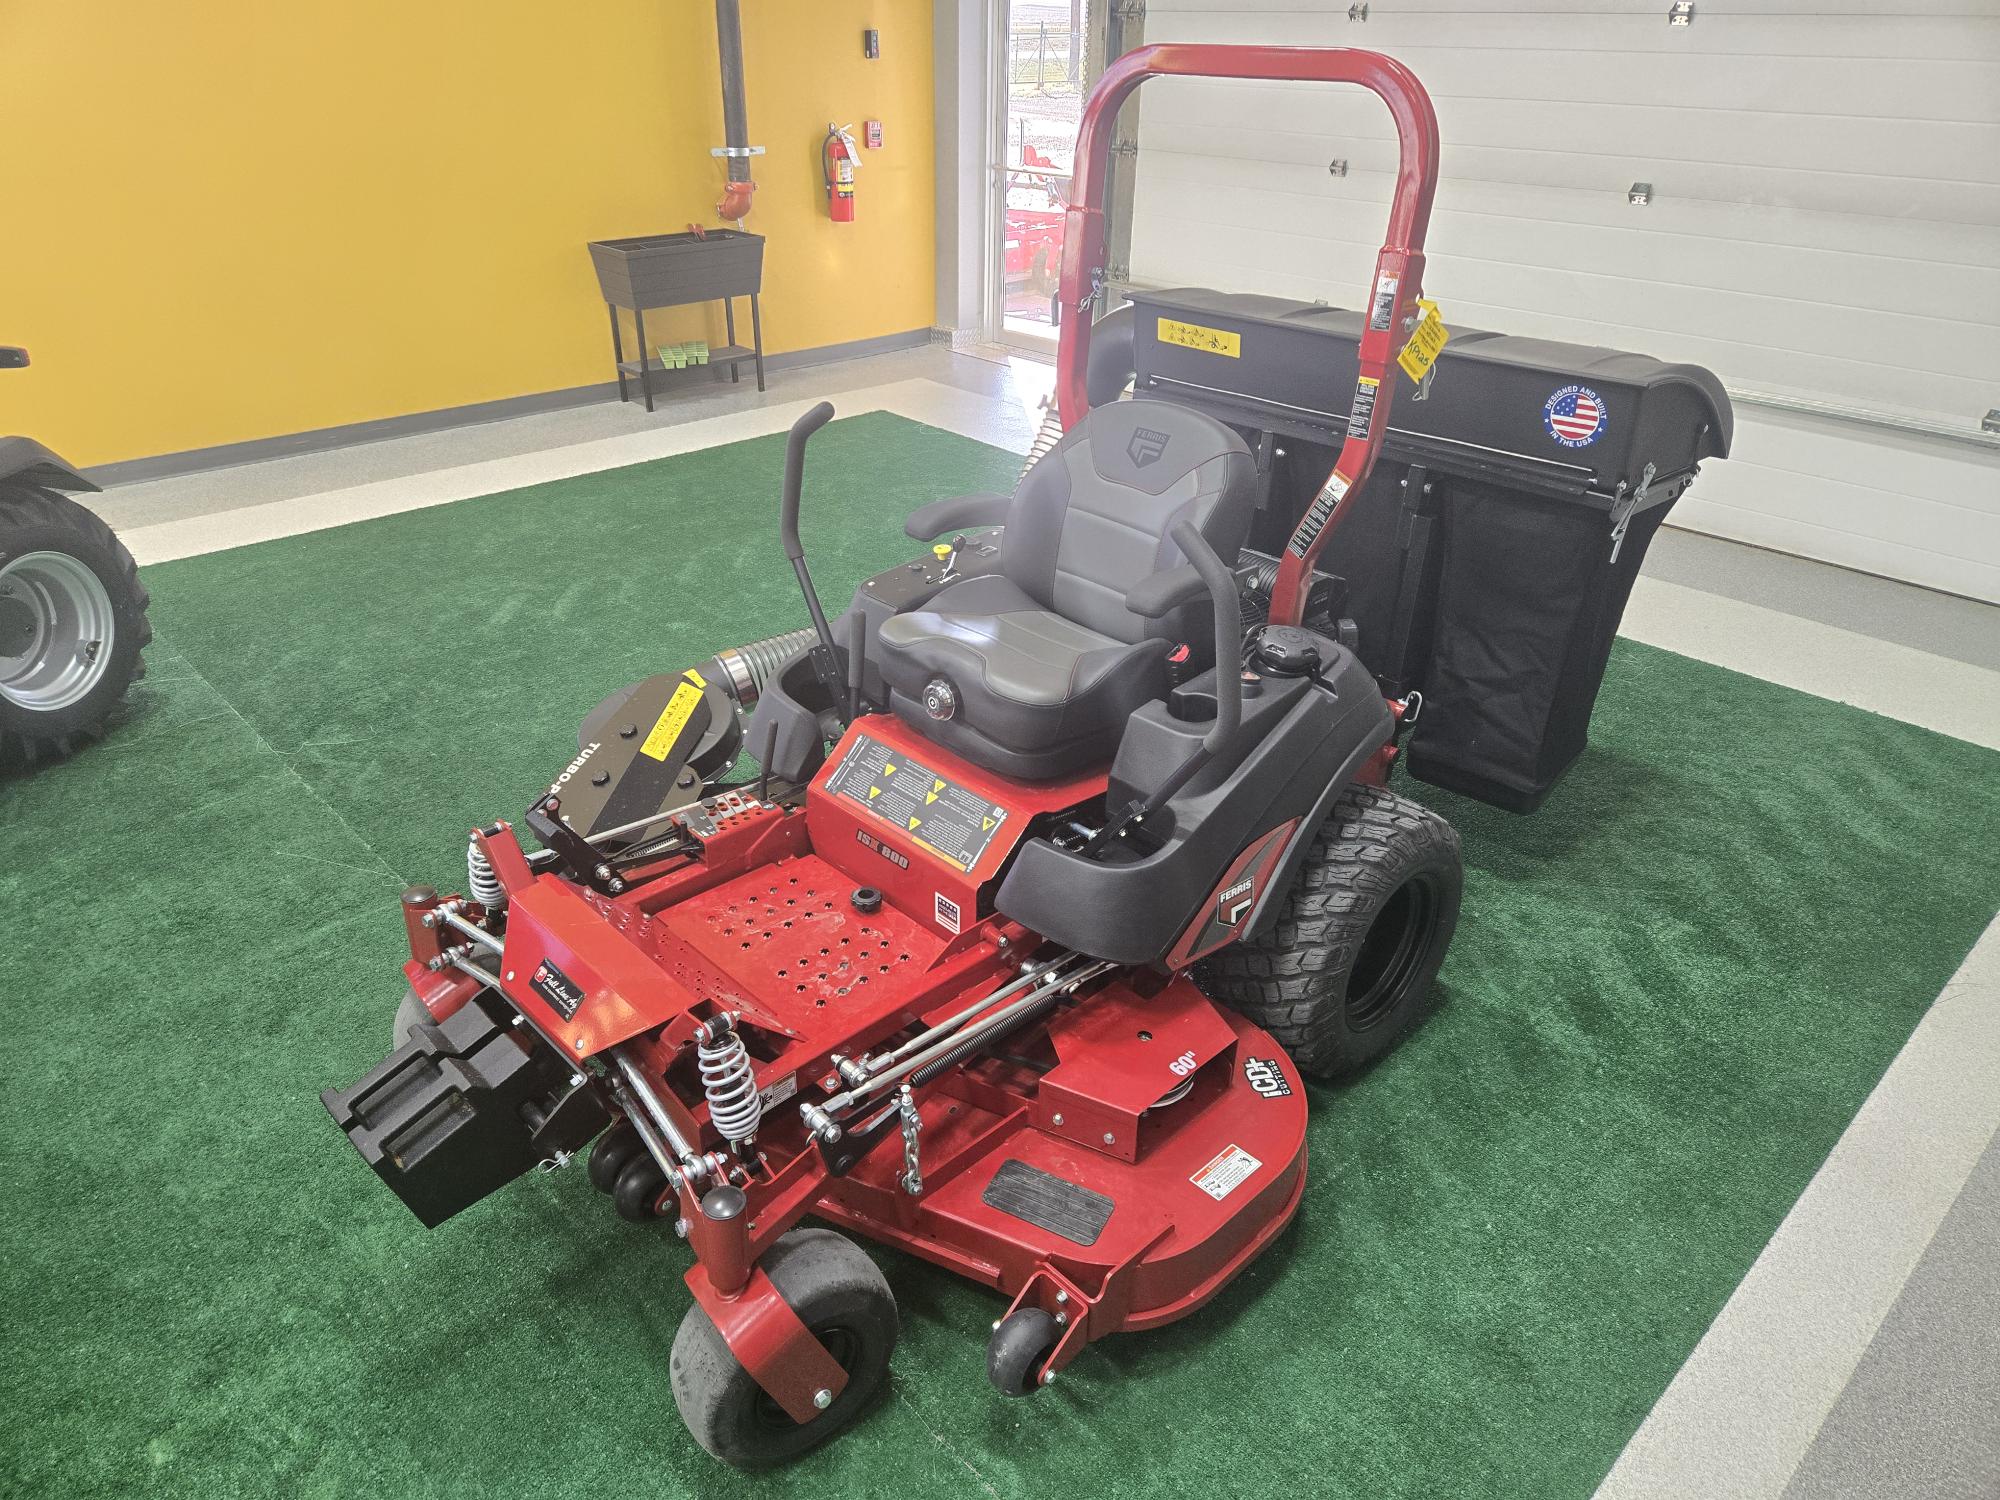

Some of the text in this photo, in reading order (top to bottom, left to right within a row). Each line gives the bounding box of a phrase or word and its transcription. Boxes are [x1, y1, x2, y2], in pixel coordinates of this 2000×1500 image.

[1545, 386, 1608, 420] DESIGNED AND BUILT
[1137, 430, 1167, 442] FERRIS
[1549, 430, 1594, 447] IN THE USA
[547, 742, 601, 794] TURBO-P
[857, 830, 908, 869] ISX 800
[1220, 880, 1252, 903] FERRIS
[544, 973, 560, 989] Full
[1169, 1050, 1197, 1076] 60"
[1268, 1060, 1292, 1096] CUTTING
